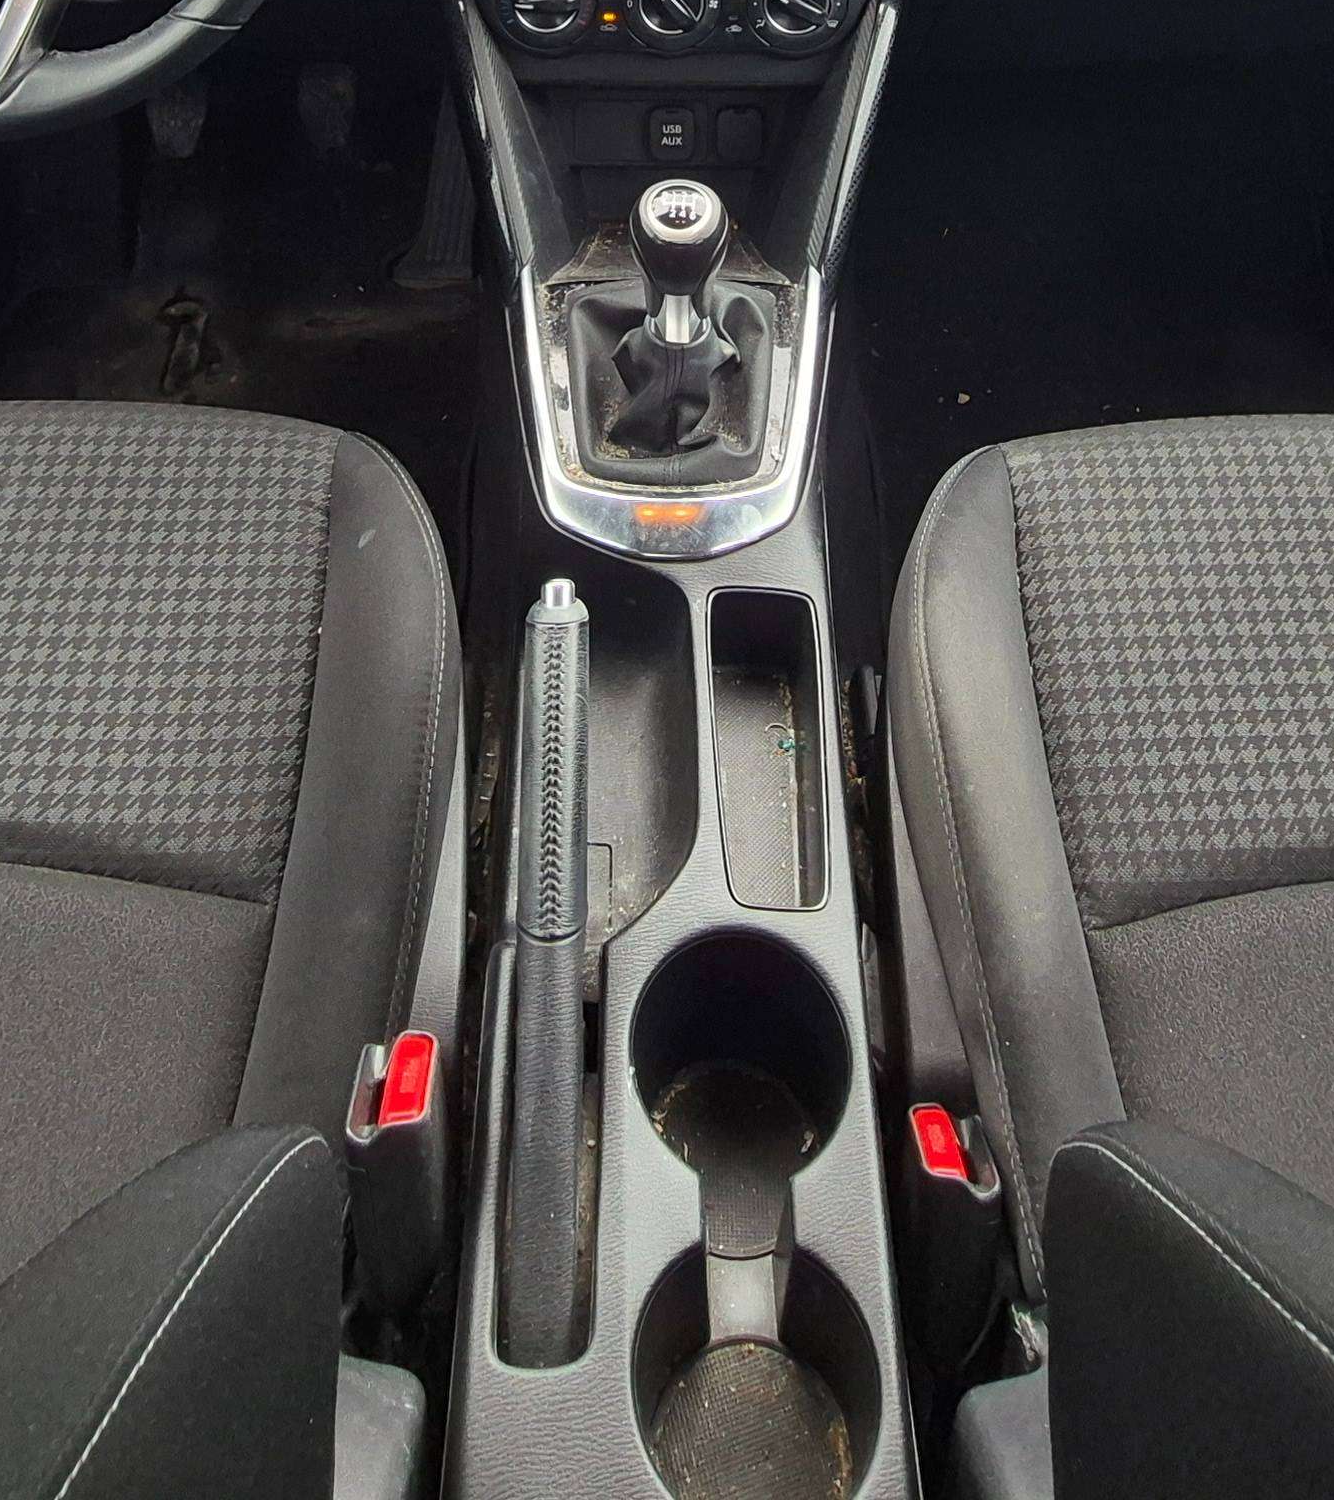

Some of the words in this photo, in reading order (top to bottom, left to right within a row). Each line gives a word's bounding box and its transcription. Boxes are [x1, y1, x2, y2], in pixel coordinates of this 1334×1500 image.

[662, 124, 682, 134] USB
[661, 136, 682, 146] AUX
[668, 210, 676, 218] 2
[679, 210, 686, 218] 4
